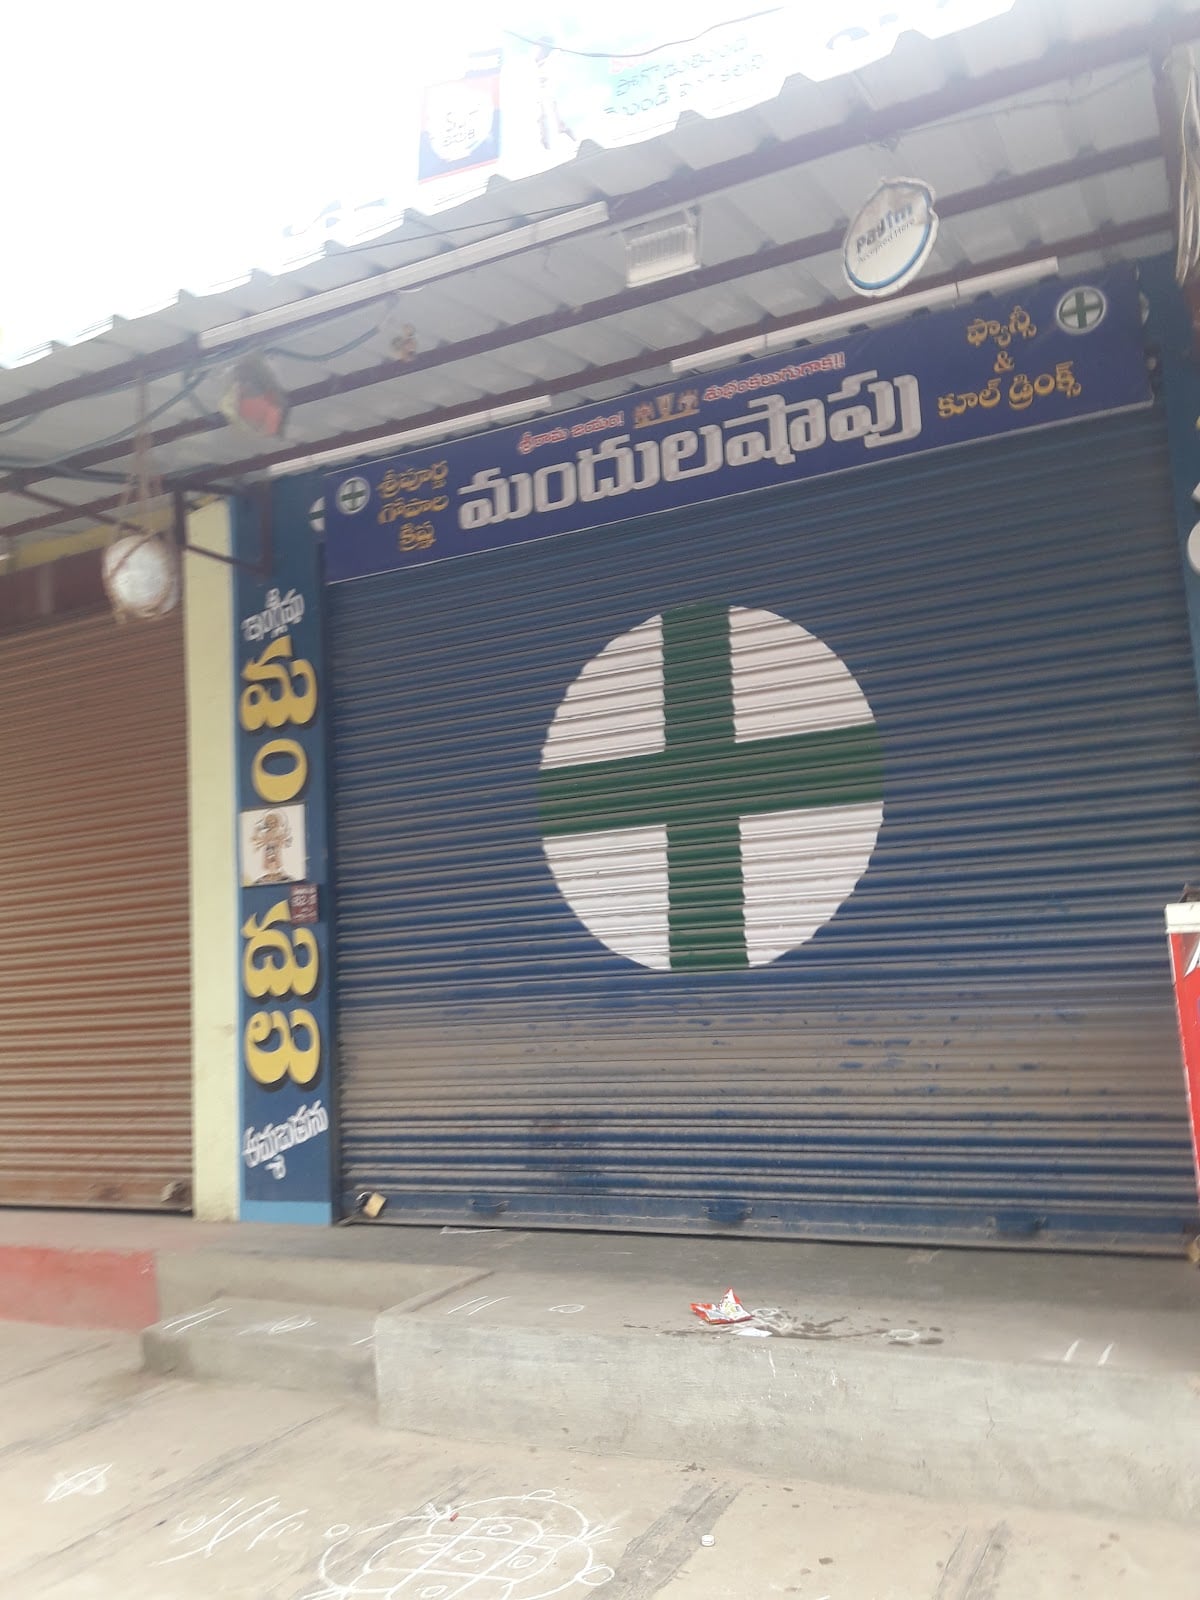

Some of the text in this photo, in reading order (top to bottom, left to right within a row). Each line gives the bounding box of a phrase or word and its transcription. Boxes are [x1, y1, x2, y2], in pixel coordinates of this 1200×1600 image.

[856, 204, 913, 254] Paytm
[993, 350, 1015, 374] &
[937, 360, 1082, 419] కూల్ డ్రింక్స్
